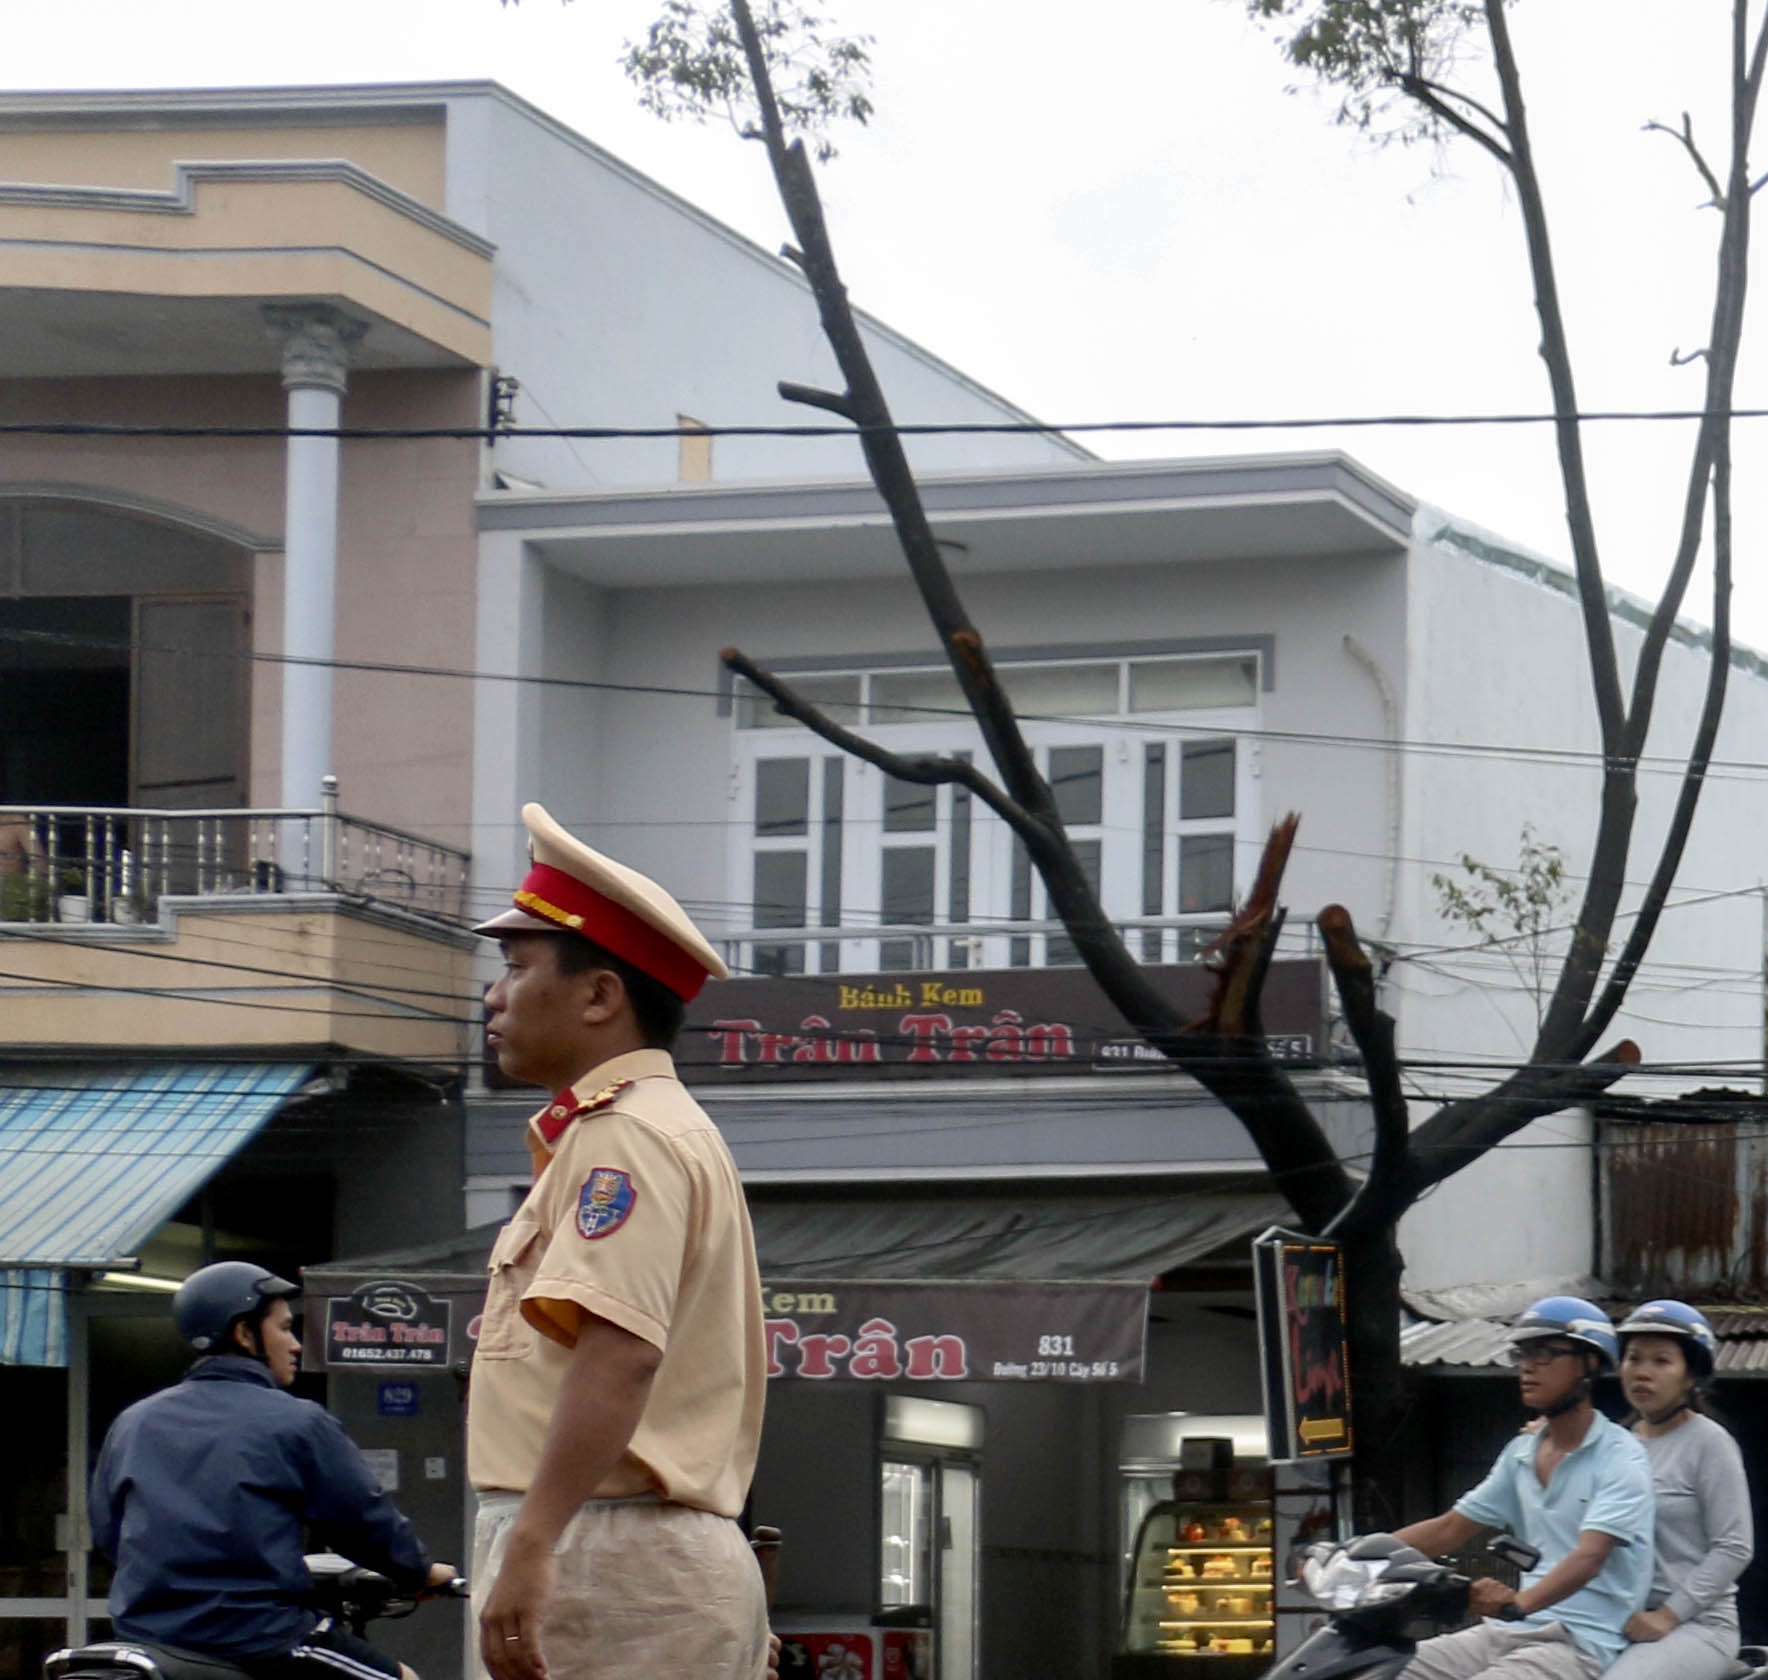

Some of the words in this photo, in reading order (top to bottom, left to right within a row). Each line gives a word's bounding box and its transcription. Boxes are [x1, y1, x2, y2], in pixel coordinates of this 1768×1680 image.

[839, 984, 912, 1009] Bánh
[921, 982, 984, 1006] Kem
[708, 1015, 881, 1068] Trân
[898, 1009, 1075, 1061] Trân
[1037, 1335, 1075, 1357] 831
[1030, 1361, 1066, 1376] 23/10
